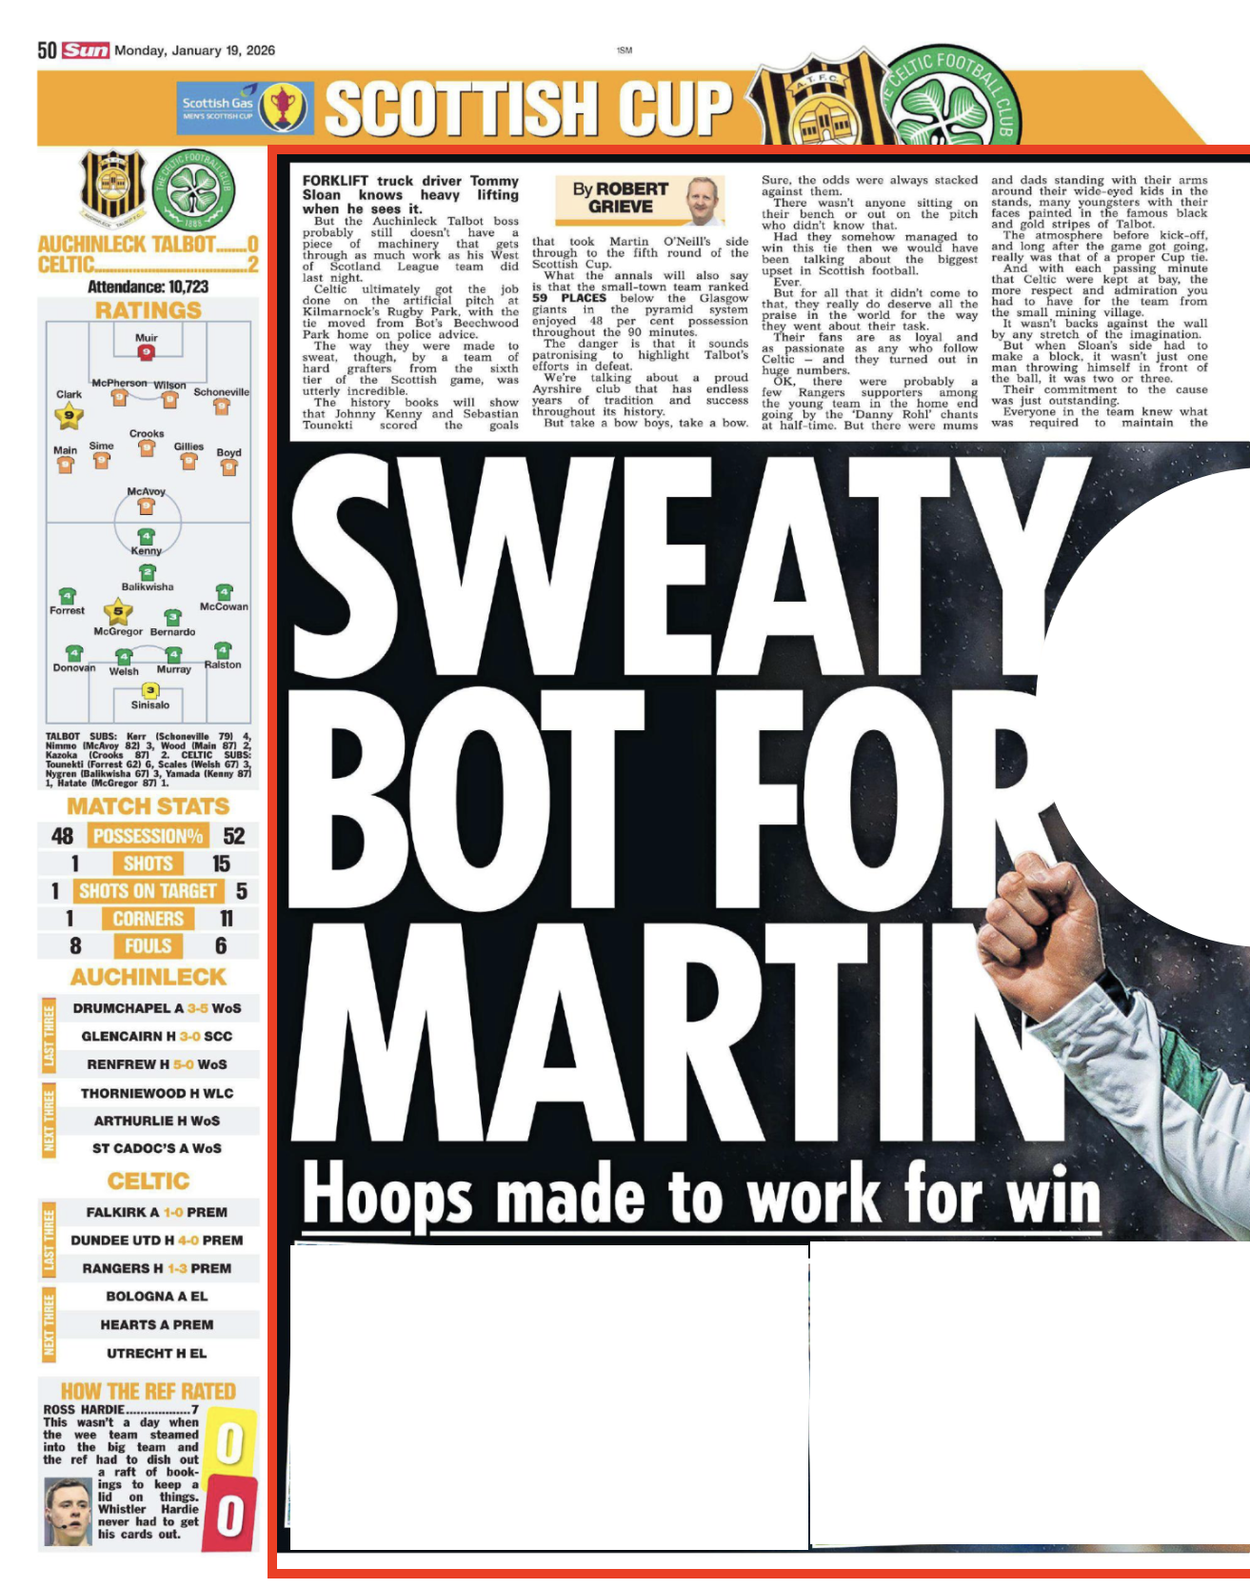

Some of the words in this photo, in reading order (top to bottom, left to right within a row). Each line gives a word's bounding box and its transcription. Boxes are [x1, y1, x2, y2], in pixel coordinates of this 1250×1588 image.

[38, 41, 57, 59] 50
[65, 43, 107, 58] Sun
[115, 45, 167, 58] Monday,
[172, 45, 221, 58] January
[227, 45, 241, 56] 19,
[247, 45, 275, 55] 2026
[182, 97, 230, 109] Scottish
[232, 97, 253, 109] Gas
[888, 54, 933, 87] CELTIC
[937, 52, 1003, 98] FOOTBALL
[996, 98, 1013, 137] CLUB
[326, 81, 596, 135] SCOTTISH
[620, 81, 731, 135] CUP
[303, 175, 368, 191] FORKLIFT
[377, 175, 413, 186] truck
[421, 175, 462, 191] driver
[470, 175, 518, 191] Tommy
[574, 183, 592, 198] By
[597, 182, 669, 195] ROBERT
[589, 200, 653, 213] GRIEVE
[992, 219, 1012, 228] and
[1020, 219, 1044, 231] gold
[1052, 220, 1090, 231] stripes
[1098, 219, 1109, 228] of
[1117, 219, 1154, 228] Talbot.
[38, 235, 146, 256] AUCHINLECK
[762, 268, 792, 279] upset
[801, 266, 811, 275] in
[819, 265, 864, 275] Scottish
[873, 266, 918, 275] football.
[88, 280, 165, 293] Attendance:
[169, 280, 208, 295] 10,723
[533, 293, 547, 302] 59
[562, 293, 606, 302] PLACES
[621, 294, 654, 302] below
[668, 294, 686, 302] the
[700, 294, 748, 304] Glasgow
[96, 301, 201, 319] RATINGS
[92, 379, 147, 387] McPherson
[194, 388, 249, 396] Schoneville
[128, 488, 165, 497] McAvoy
[132, 547, 161, 556] Kenny
[291, 453, 1093, 678] SWEATY
[95, 627, 142, 637] McGregor
[68, 797, 151, 815] MATCH
[157, 797, 230, 815] STATS
[288, 687, 645, 913] BOT
[716, 687, 1057, 913] FOR
[52, 827, 73, 844] 48
[94, 829, 202, 843] POSSESSION%
[224, 827, 245, 844] 52
[52, 883, 58, 899] 1
[80, 883, 128, 898] SHOTS
[134, 883, 154, 898] ON
[160, 883, 217, 898] TARGET
[237, 883, 247, 899] 5
[67, 910, 72, 926] 1
[114, 911, 183, 926] CORNERS
[221, 910, 232, 926] 11
[70, 968, 226, 986] AUCHINLECK
[74, 1003, 171, 1013] DRUMCHAPEL
[175, 1003, 184, 1013] A
[188, 1004, 208, 1013] 3-5
[212, 1003, 241, 1013] WoS
[44, 1006, 54, 1037] THREE
[290, 923, 1066, 1142] MARTIN
[44, 1042, 53, 1066] LAST
[108, 1172, 189, 1190] CELTIC
[305, 1160, 472, 1237] Hoops
[498, 1160, 644, 1223] made
[669, 1172, 722, 1223] to
[747, 1160, 882, 1223] work
[905, 1160, 982, 1223] for
[1007, 1164, 1099, 1222] win
[87, 1207, 146, 1217] FALKIRK
[150, 1207, 159, 1217] A
[165, 1208, 183, 1217] 1-0
[188, 1207, 227, 1217] PREM
[44, 1211, 53, 1241] THREE
[44, 1246, 54, 1270] LAST
[101, 1320, 156, 1330] HEARTS
[160, 1320, 169, 1329] A
[174, 1320, 213, 1330] PREM
[61, 1382, 102, 1400] HOW
[107, 1382, 139, 1400] THE
[145, 1382, 177, 1400] REF
[182, 1382, 236, 1400] RATED
[44, 1417, 67, 1427] This
[78, 1418, 113, 1427] wasn't
[140, 1418, 159, 1428] day
[169, 1417, 198, 1427] when
[217, 1422, 243, 1464] 0
[217, 1495, 243, 1538] 0
